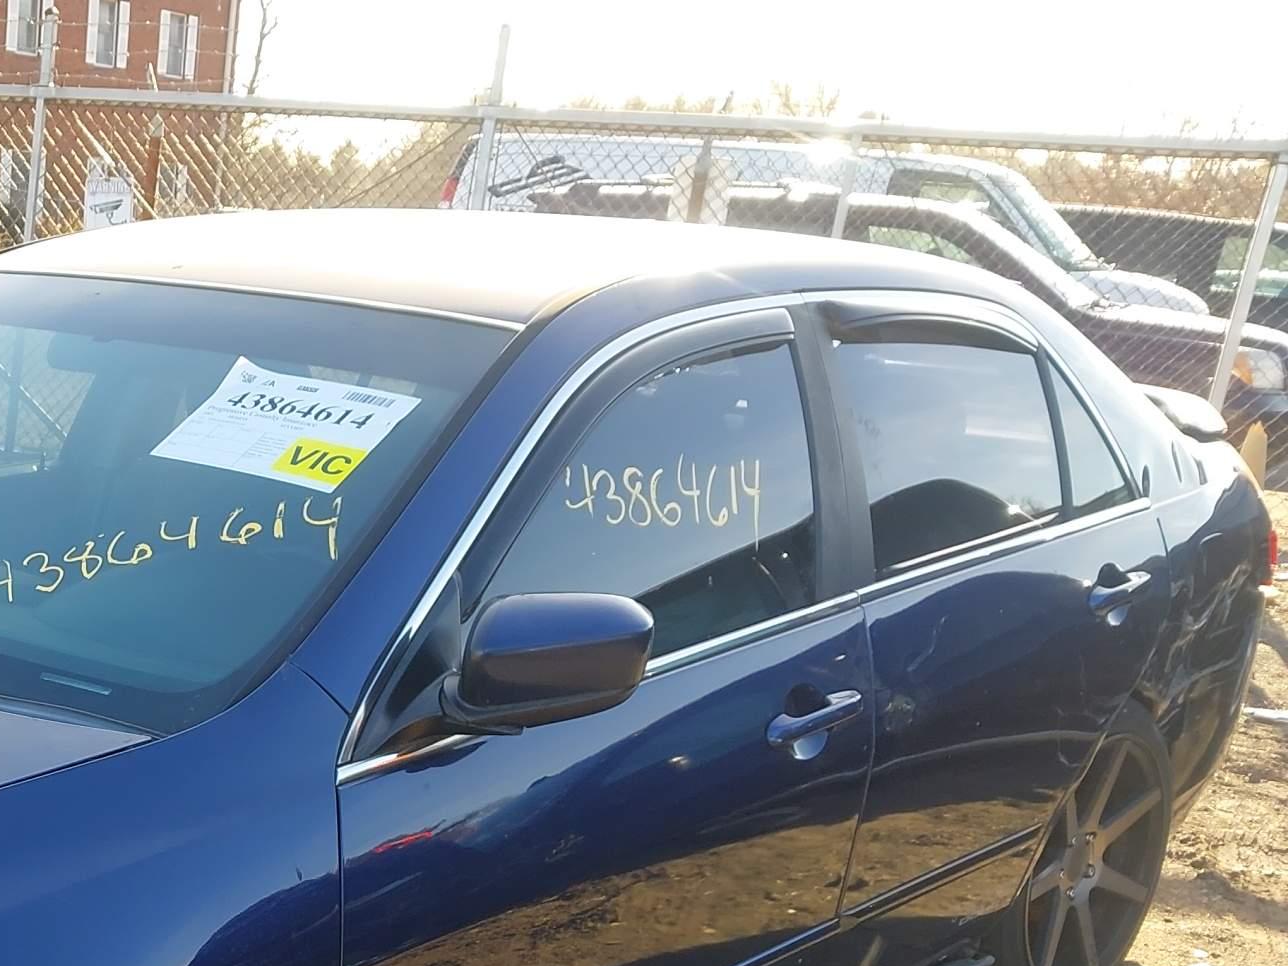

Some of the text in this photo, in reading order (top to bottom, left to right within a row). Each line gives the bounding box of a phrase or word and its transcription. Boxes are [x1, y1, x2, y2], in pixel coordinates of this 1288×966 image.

[227, 391, 376, 430] 43864614
[289, 445, 353, 476] VIC
[565, 453, 760, 551] 43864614
